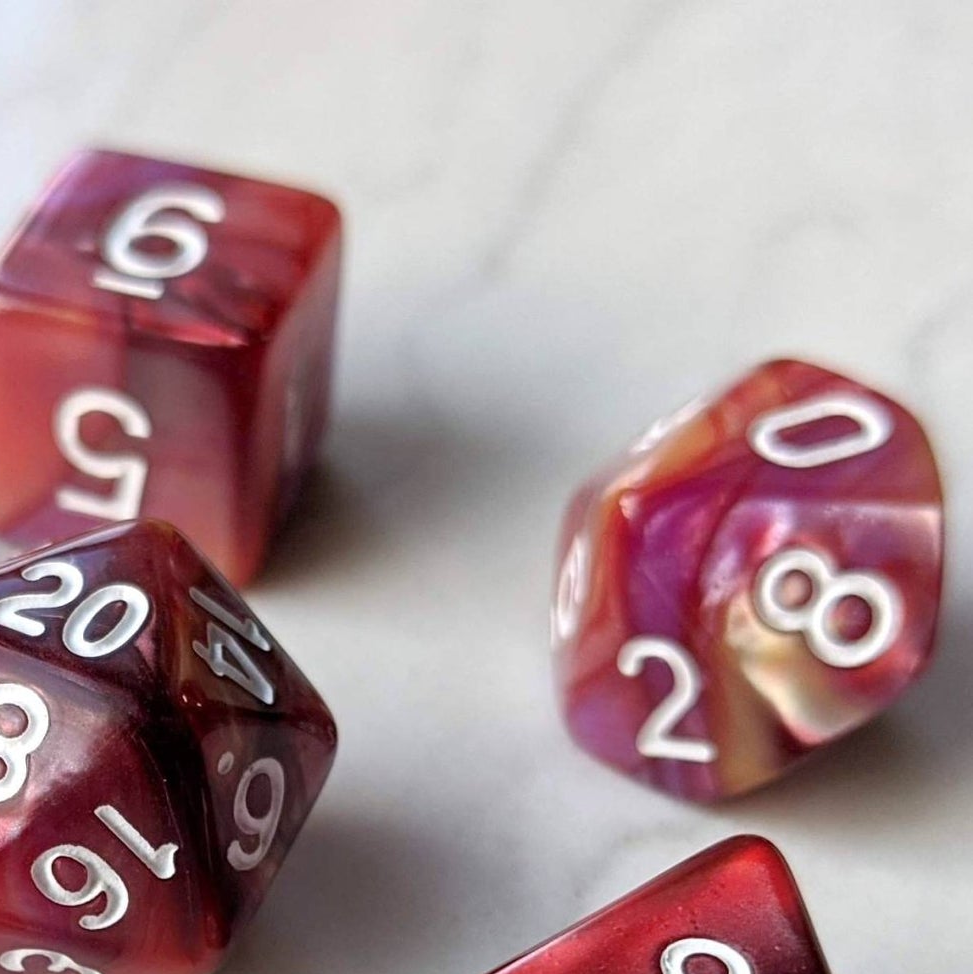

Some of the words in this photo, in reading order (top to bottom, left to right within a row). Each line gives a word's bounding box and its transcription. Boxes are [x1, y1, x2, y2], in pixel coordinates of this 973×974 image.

[53, 387, 152, 522] 5
[749, 397, 893, 468] 0
[190, 586, 274, 706] 14
[757, 548, 900, 668] 8
[618, 637, 716, 763] 2
[31, 804, 179, 931] 16
